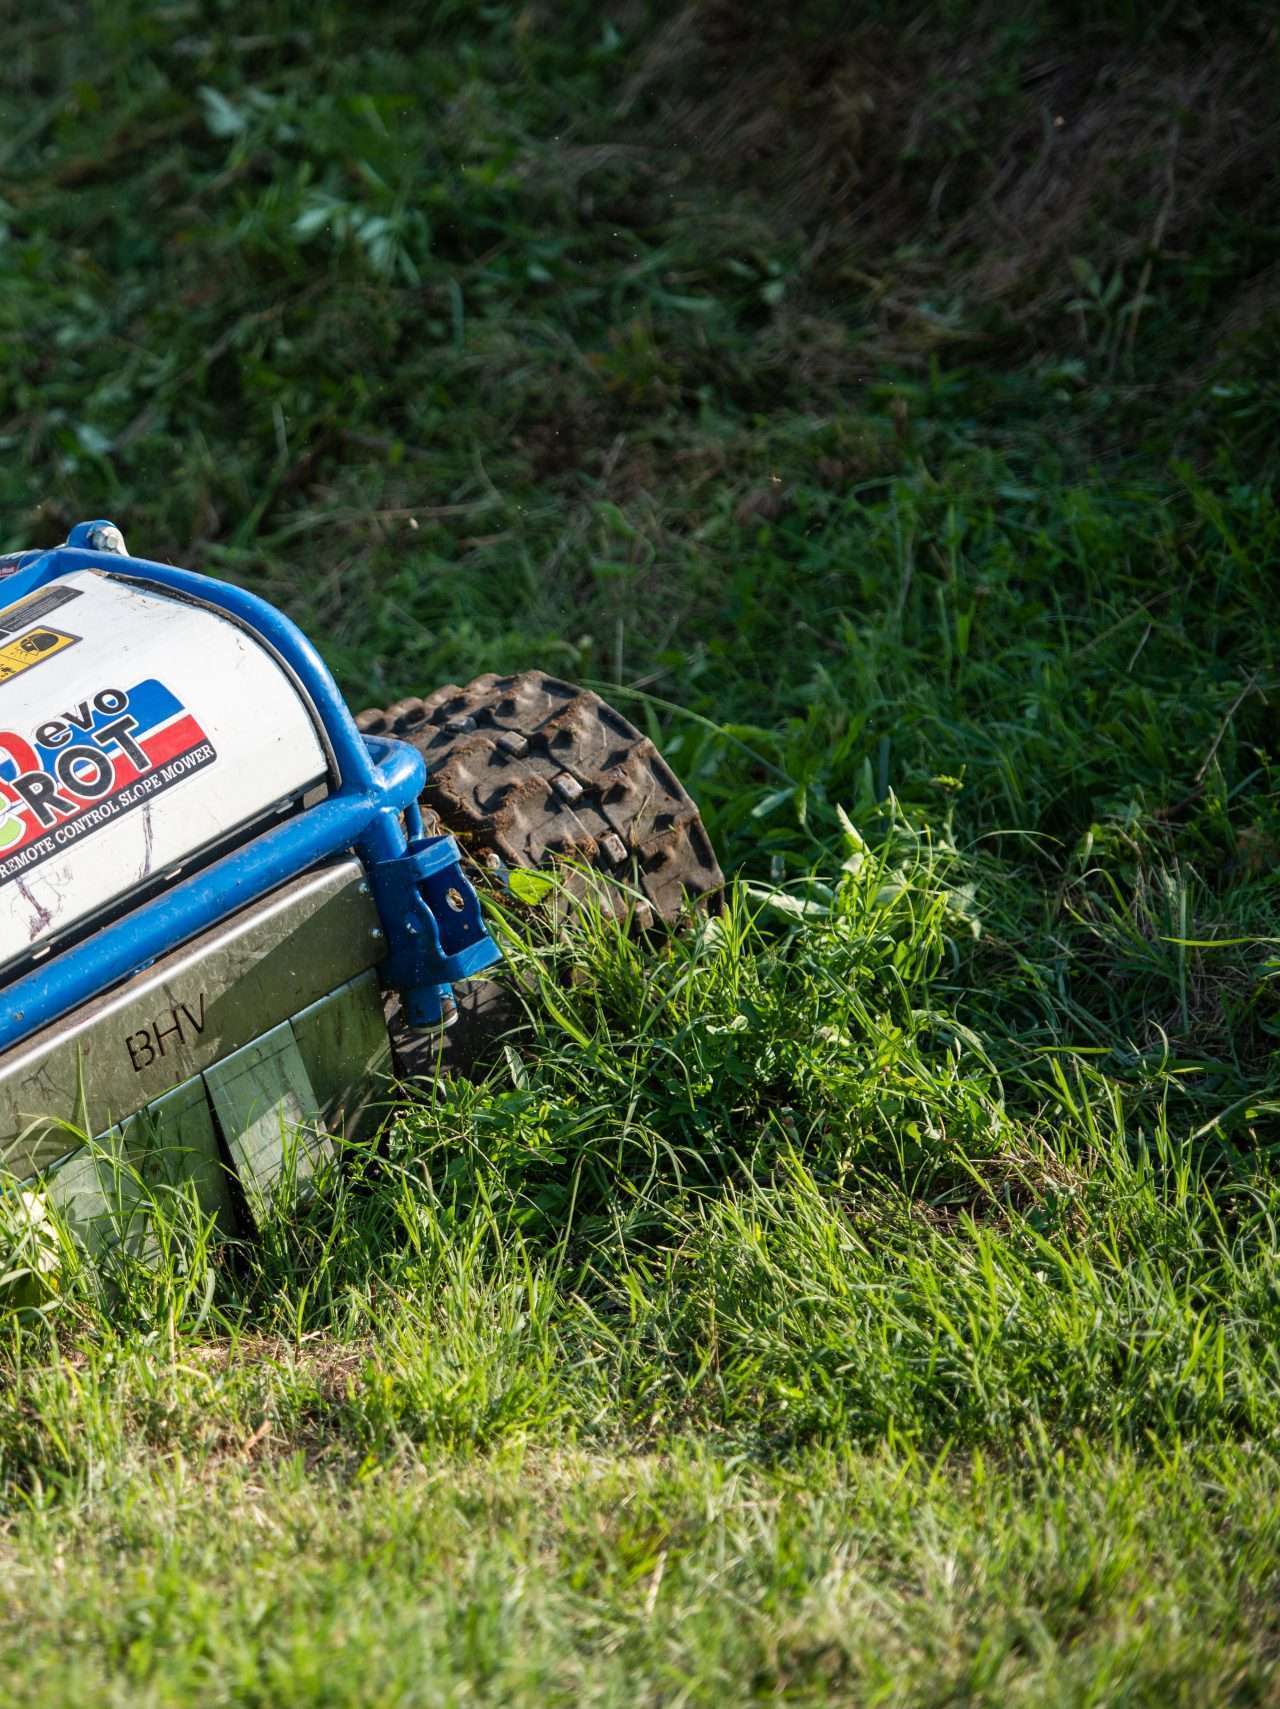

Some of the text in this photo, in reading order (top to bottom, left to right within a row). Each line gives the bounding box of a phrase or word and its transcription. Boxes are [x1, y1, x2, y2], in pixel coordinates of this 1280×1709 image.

[35, 688, 128, 748] evo
[55, 800, 120, 844] CONTROL
[118, 774, 163, 809] SLOPE
[161, 744, 215, 783] MOWER
[125, 993, 205, 1072] BHV
